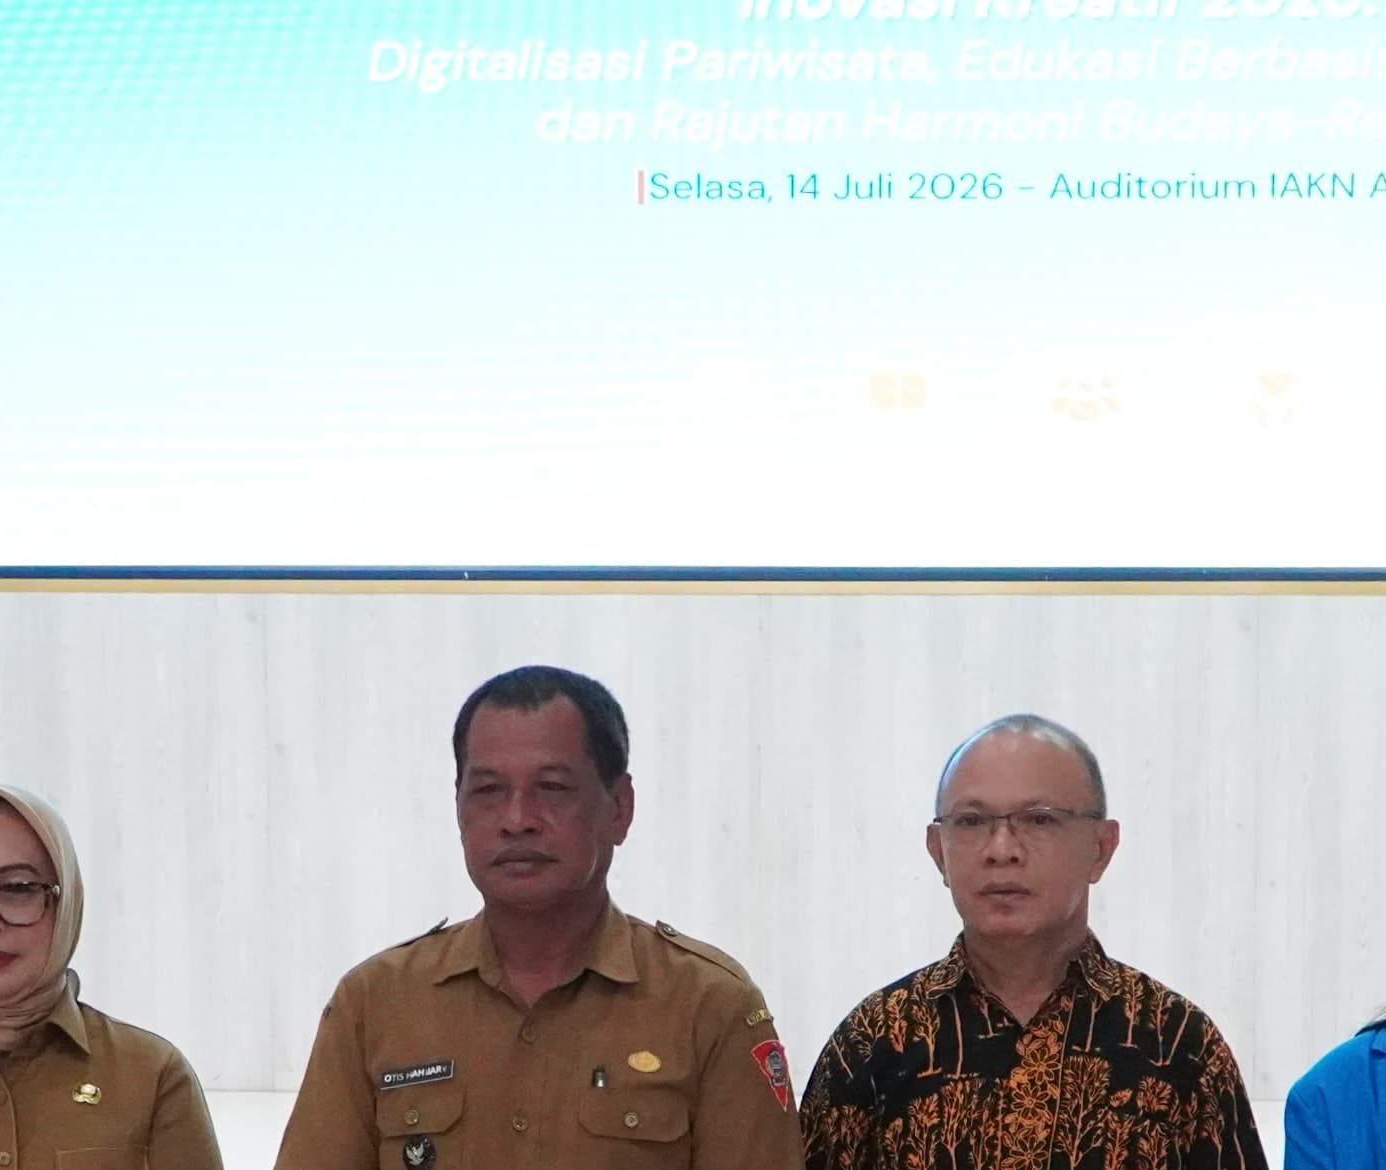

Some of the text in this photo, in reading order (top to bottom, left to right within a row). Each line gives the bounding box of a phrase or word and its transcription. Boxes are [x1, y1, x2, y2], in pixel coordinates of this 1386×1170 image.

[367, 38, 647, 93] Digitalisasi
[662, 38, 938, 85] Pariwisata,
[956, 37, 1163, 81] Edukasi
[536, 101, 635, 144] dan
[651, 101, 845, 151] Rajutan
[863, 99, 1083, 144] Harmoni
[648, 170, 774, 204] Selasa,
[785, 171, 821, 201] 14
[832, 171, 895, 201] Juli
[907, 171, 1005, 201] 2026
[1049, 171, 1259, 201] Auditorium
[1268, 171, 1357, 200] IAKN
